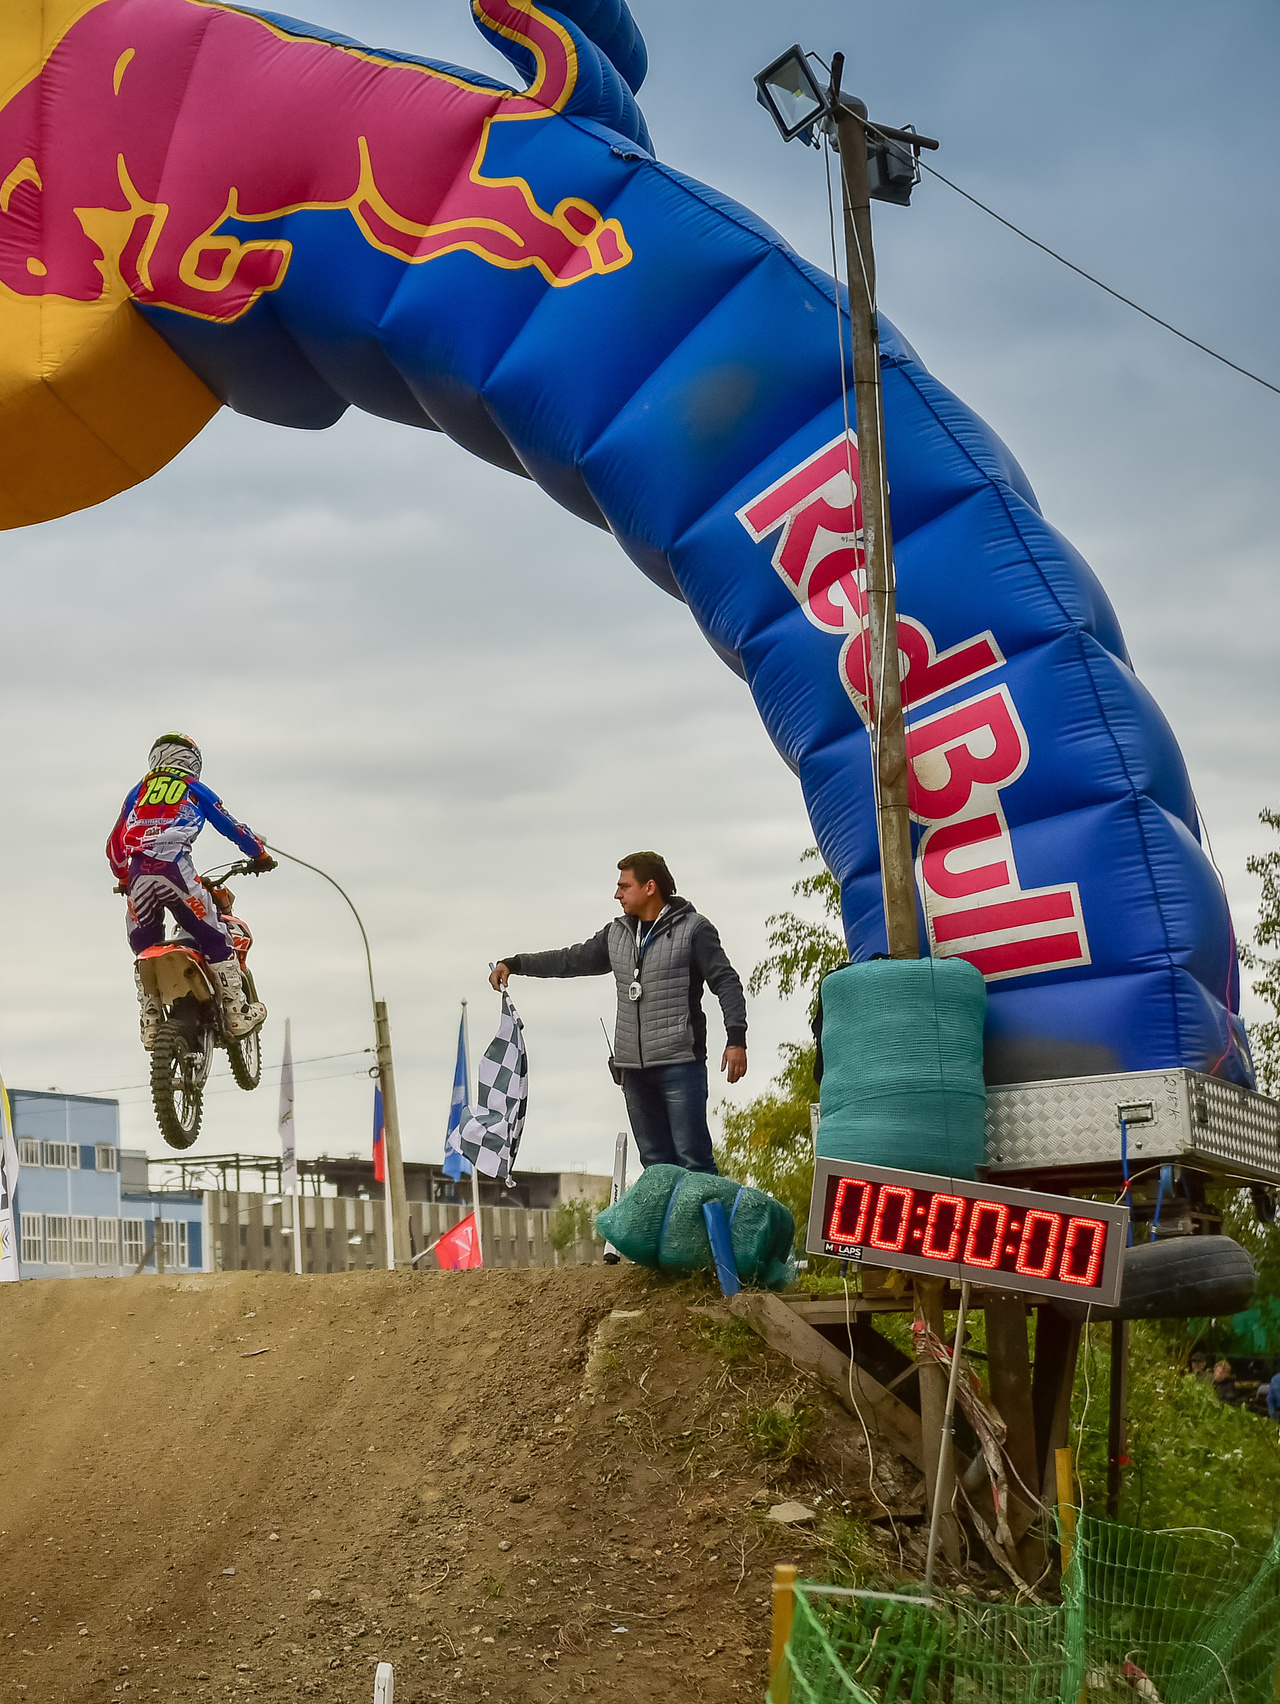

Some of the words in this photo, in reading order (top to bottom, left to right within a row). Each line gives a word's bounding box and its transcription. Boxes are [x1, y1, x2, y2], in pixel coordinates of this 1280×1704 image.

[904, 683, 1091, 981] Bull
[186, 896, 207, 920] KTM
[828, 1177, 1106, 1286] 00:00:00
